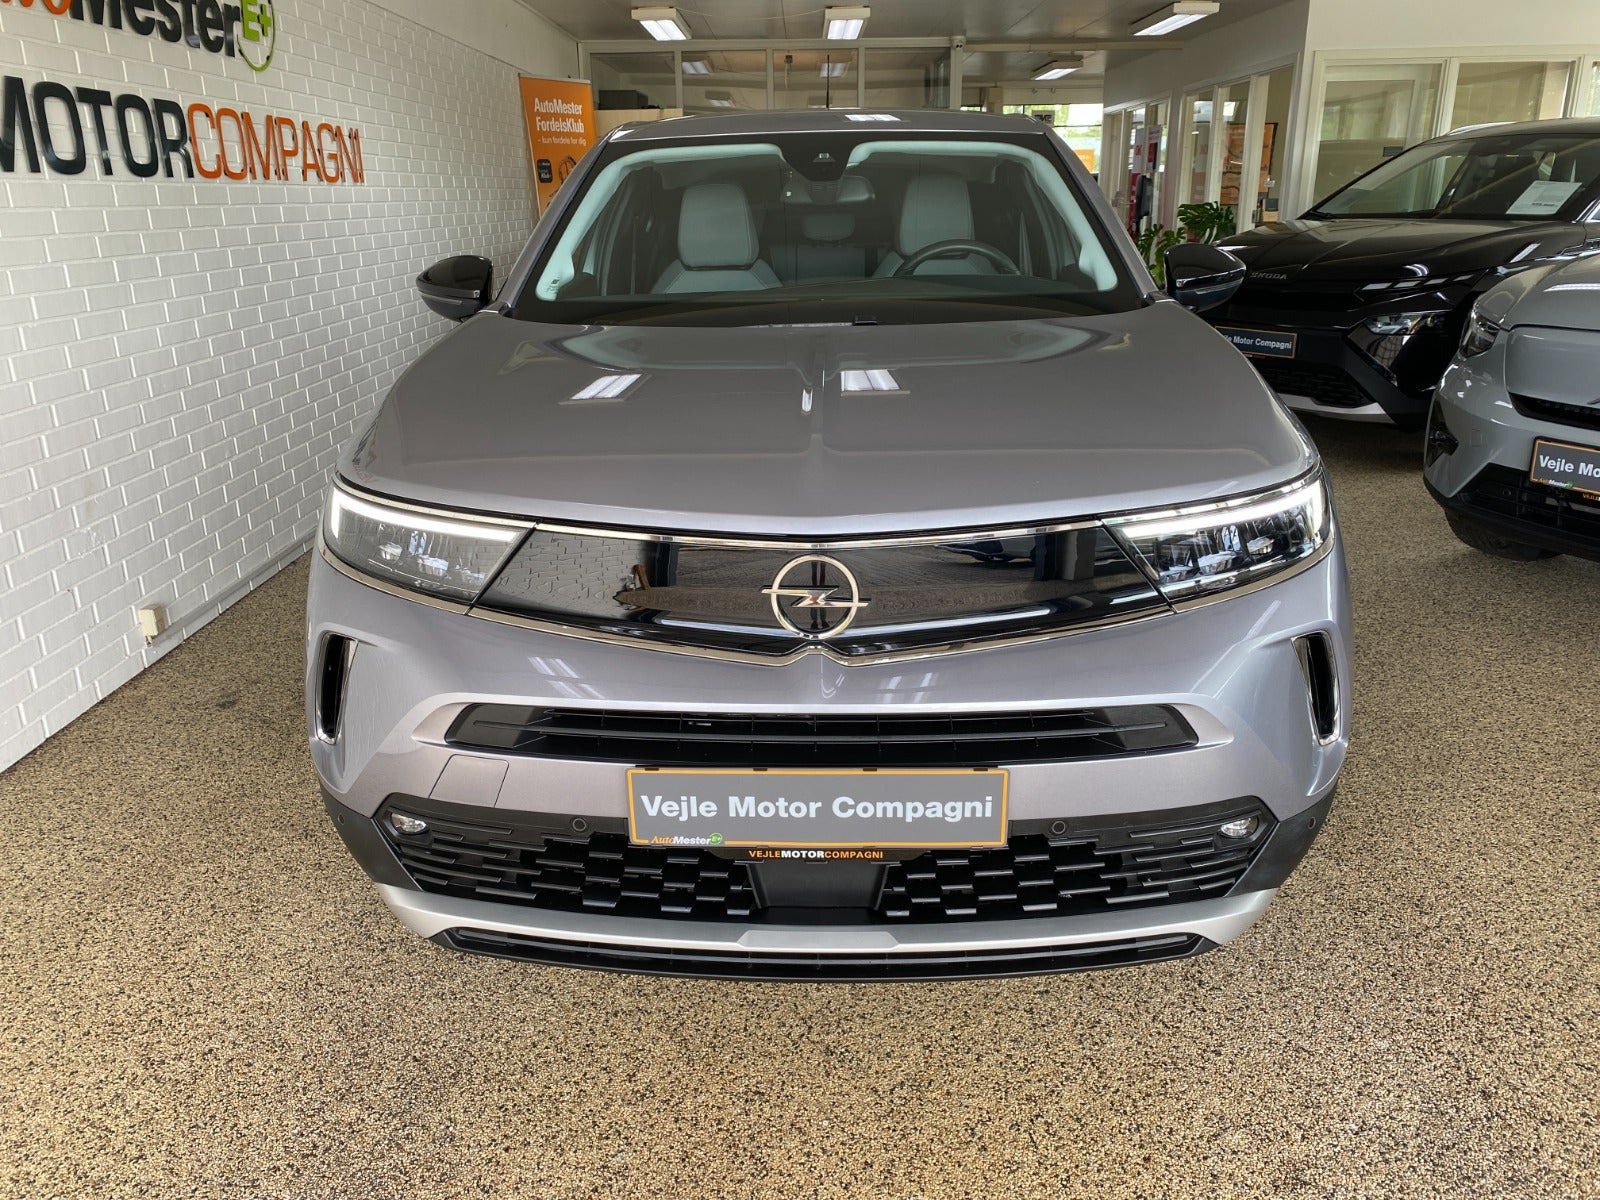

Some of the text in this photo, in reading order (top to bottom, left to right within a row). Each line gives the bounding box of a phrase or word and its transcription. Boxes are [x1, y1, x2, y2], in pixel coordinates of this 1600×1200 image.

[534, 97, 582, 115] AutoMester
[535, 116, 584, 133] FordelsKlub
[1233, 335, 1254, 345] Motor
[1255, 338, 1292, 350] Compagni
[1539, 455, 1574, 473] Vejle
[640, 795, 993, 823] Vejle Motor Compagni
[651, 835, 711, 845] AutoMester
[748, 850, 884, 859] VEJLEMOTORCOMPAGNI
